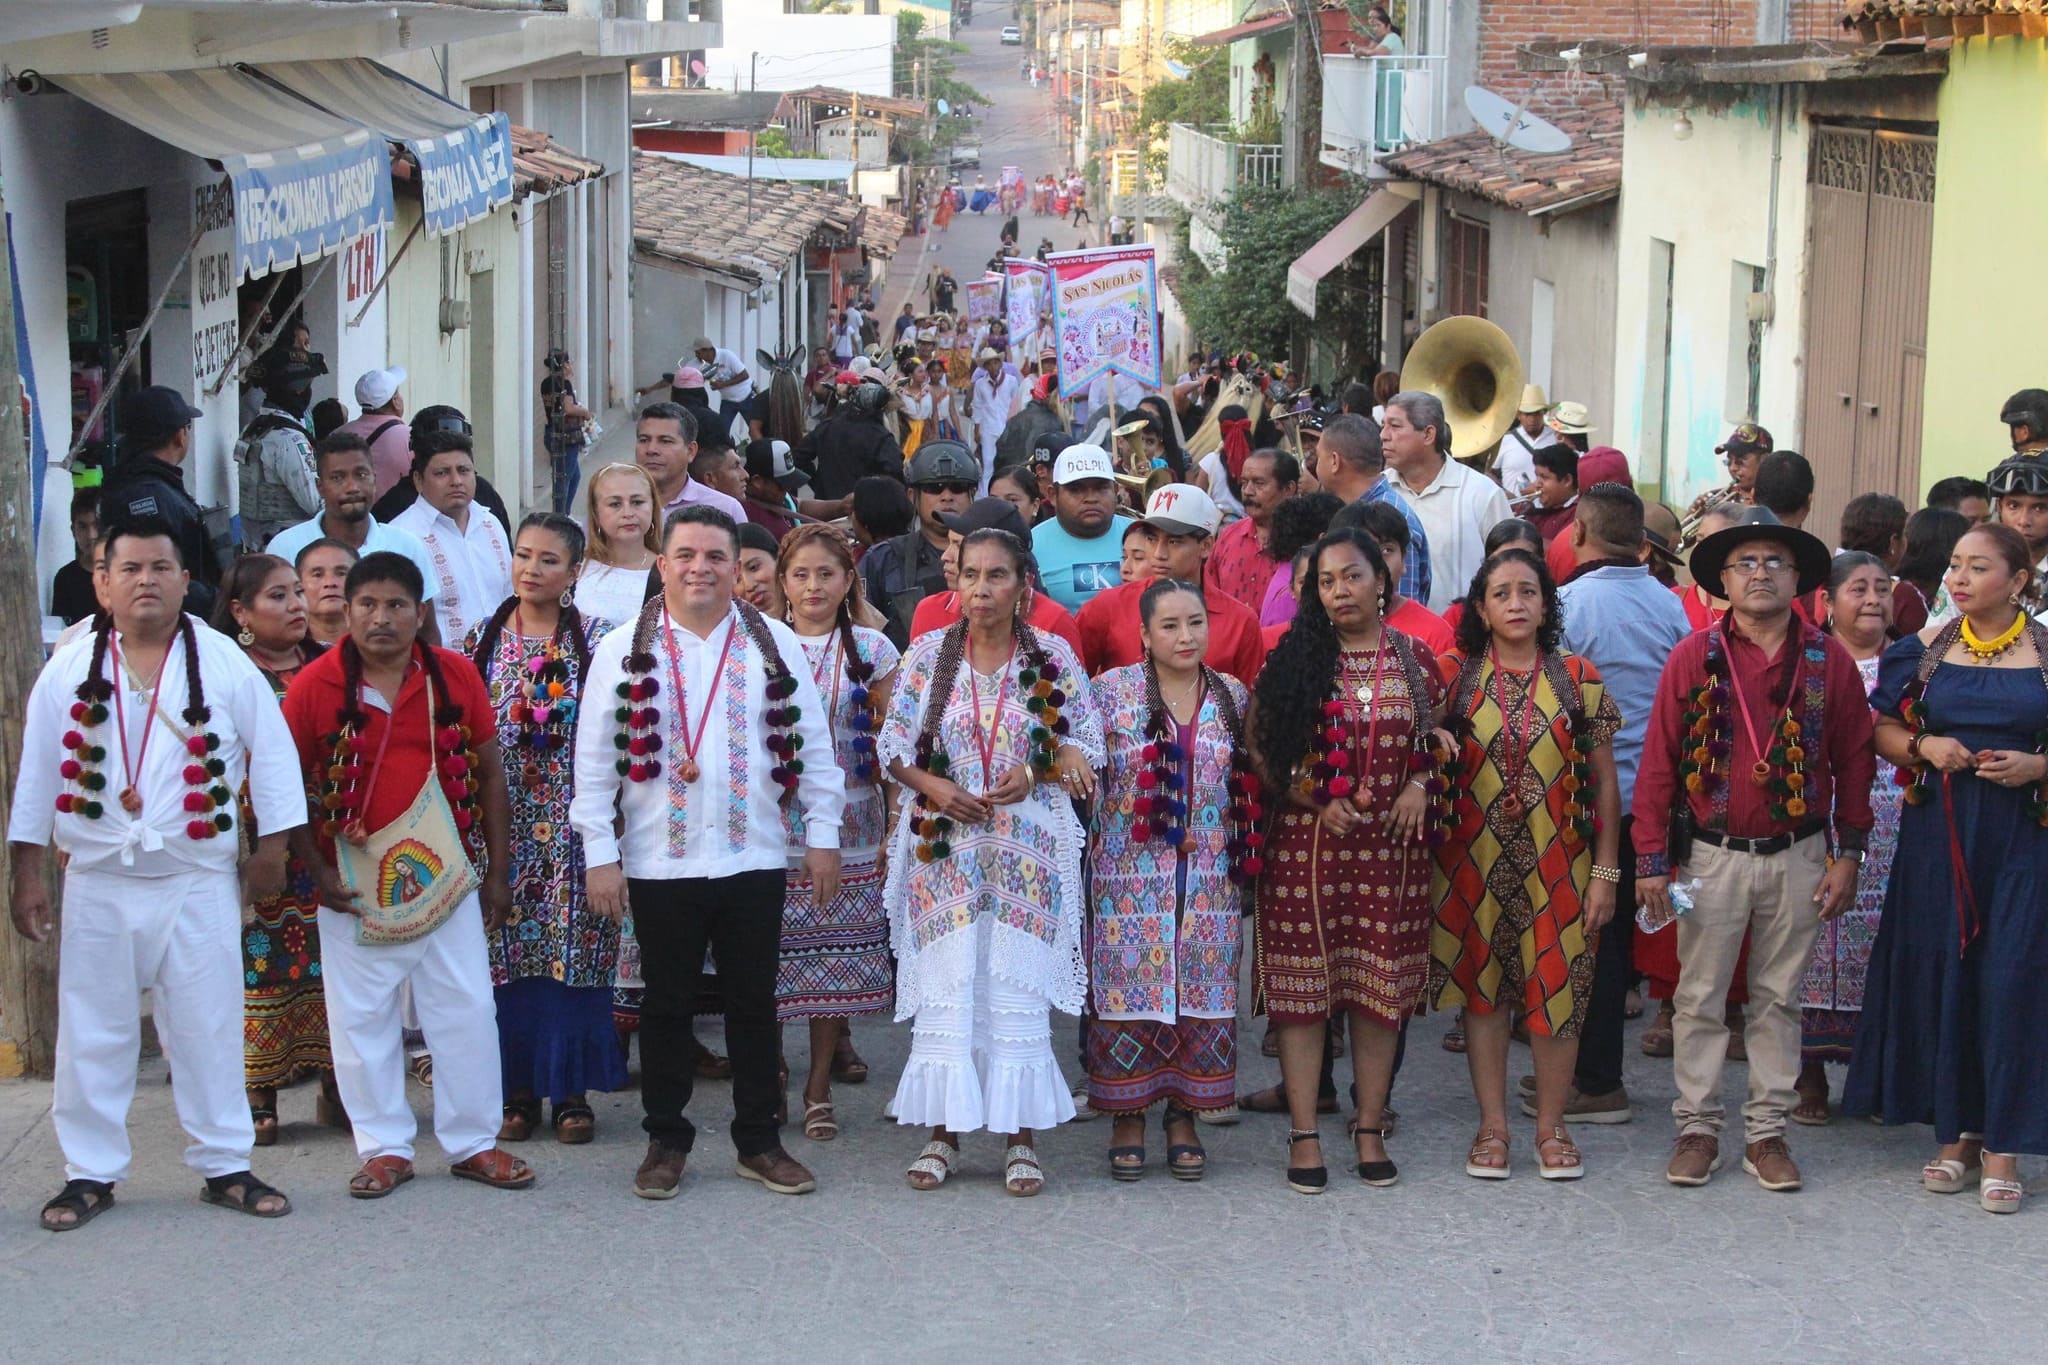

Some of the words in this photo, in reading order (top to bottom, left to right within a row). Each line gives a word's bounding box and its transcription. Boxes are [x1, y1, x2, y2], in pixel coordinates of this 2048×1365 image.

[200, 254, 217, 310] QUE
[218, 252, 230, 299] NO
[347, 233, 374, 302] LTH
[1063, 283, 1089, 304] SAN
[194, 330, 204, 379] SE
[206, 320, 236, 375] DETIENE
[1035, 448, 1050, 461] 68
[1080, 563, 1113, 590] CK
[388, 904, 441, 934] GUADALUPE
